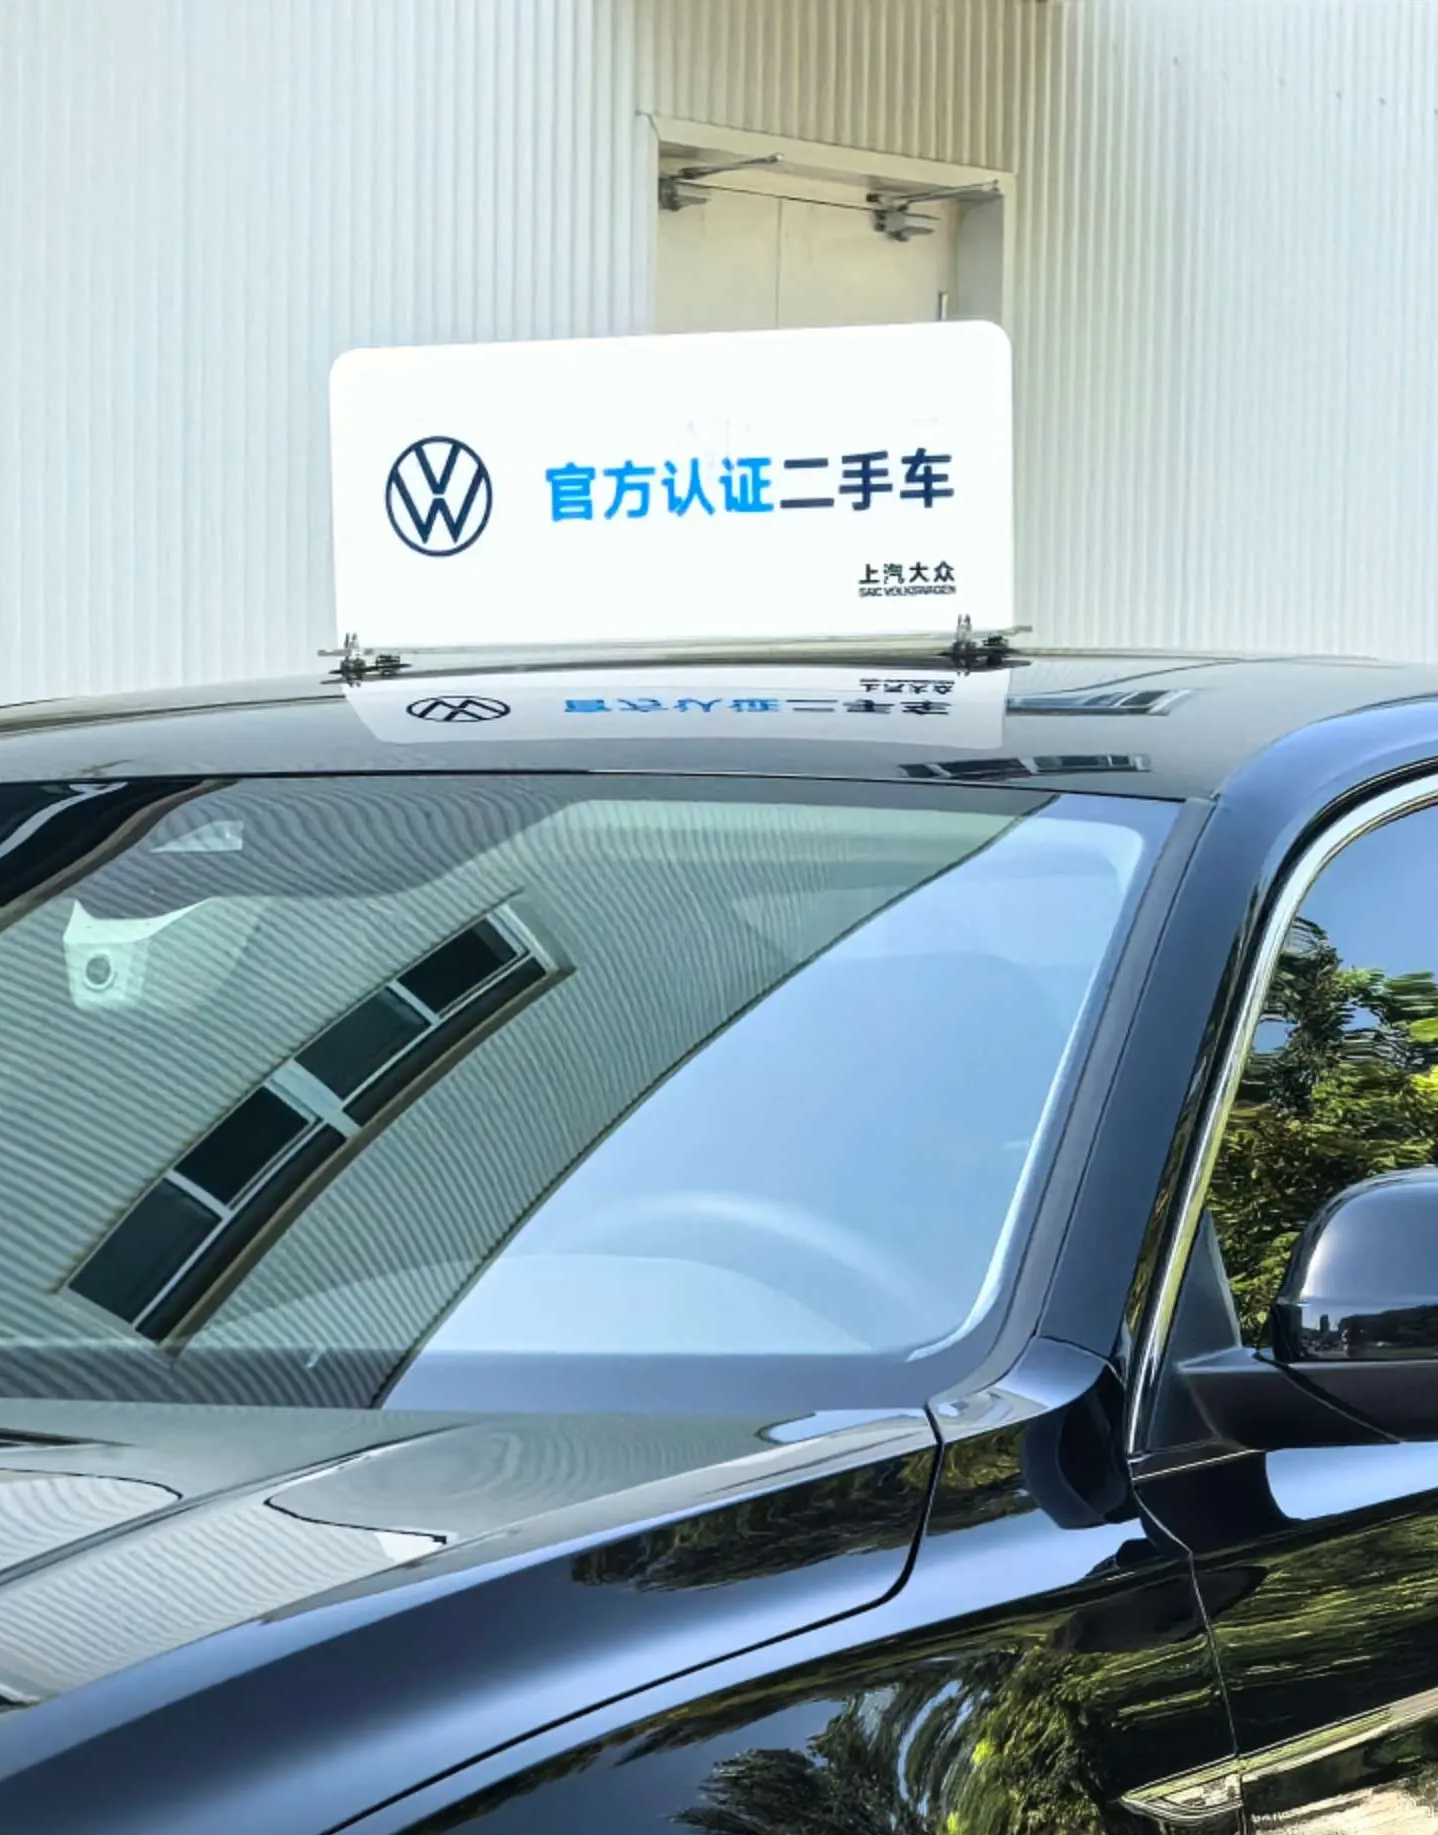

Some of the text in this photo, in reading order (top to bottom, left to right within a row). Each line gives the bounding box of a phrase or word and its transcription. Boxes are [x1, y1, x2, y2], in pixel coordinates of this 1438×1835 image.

[385, 436, 493, 557] VW
[545, 448, 955, 522] 官方认证二手车
[859, 560, 955, 584] 上汽大众
